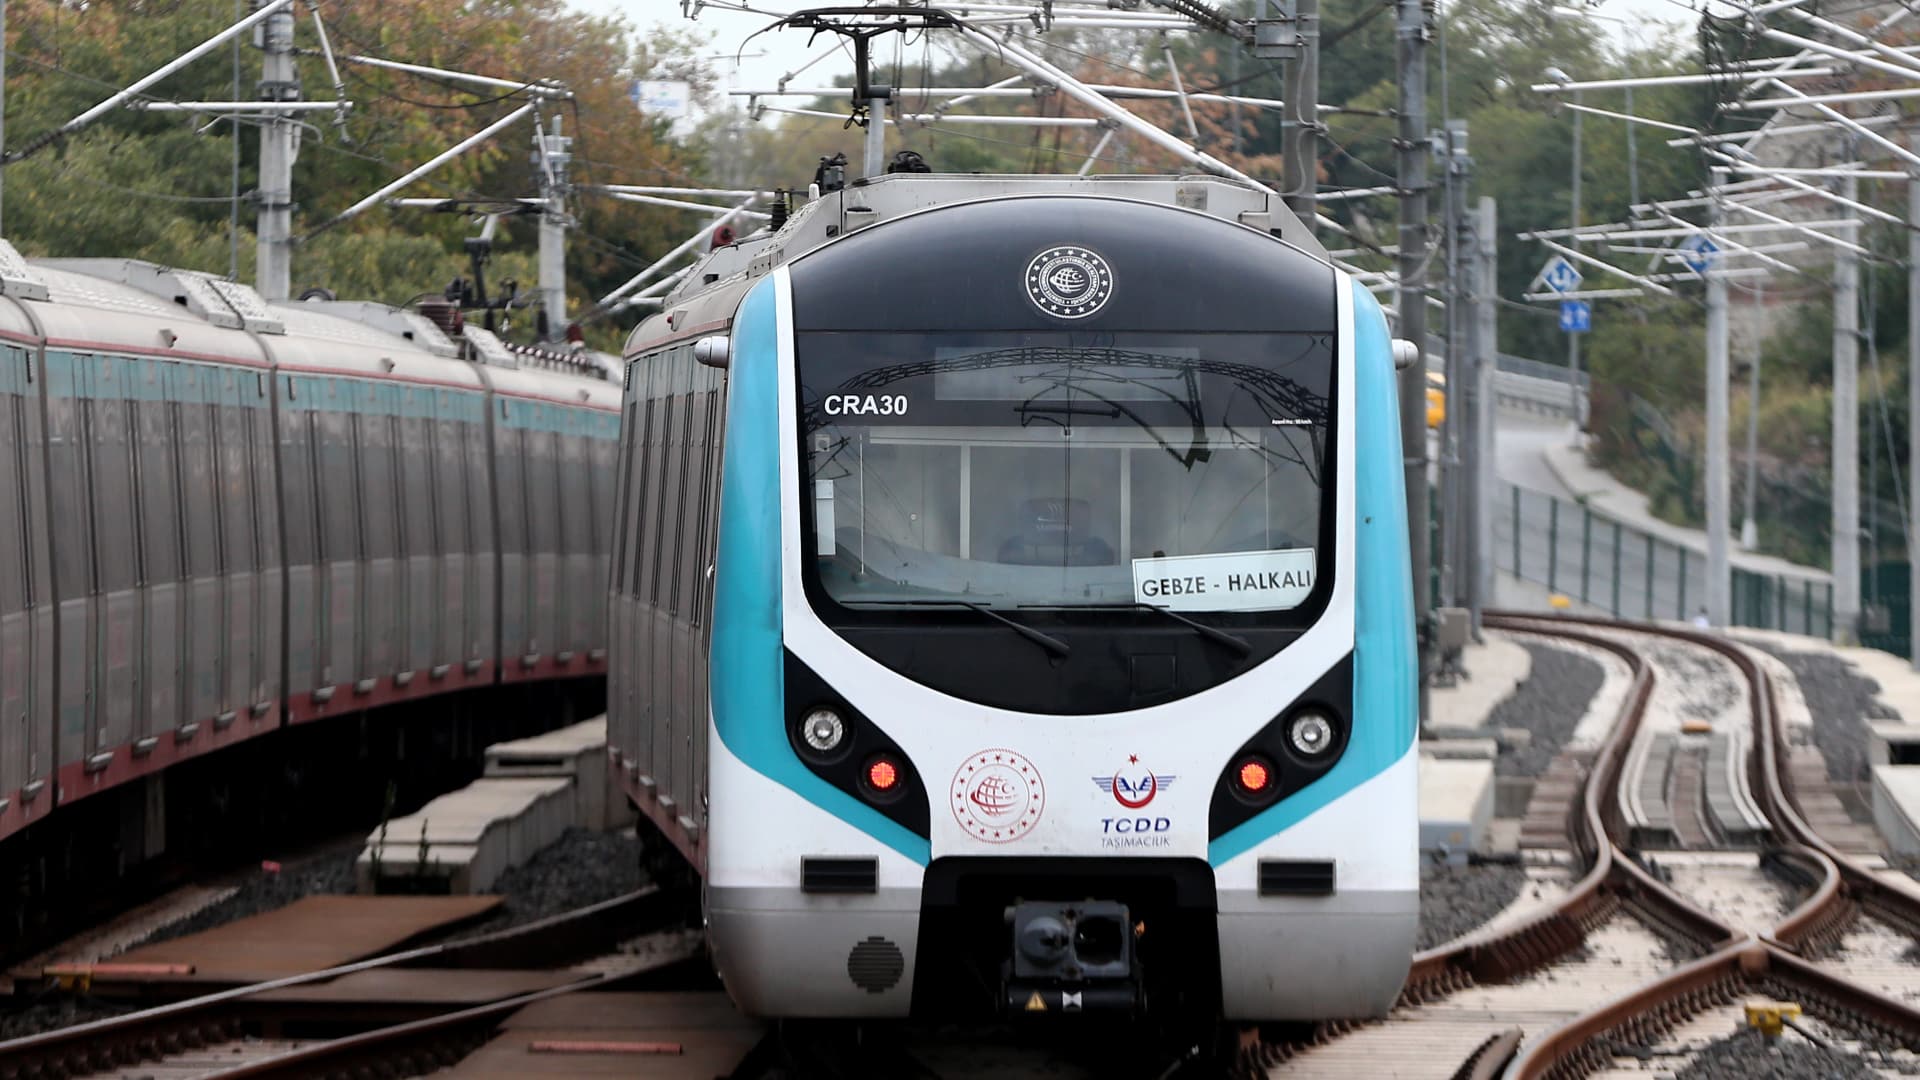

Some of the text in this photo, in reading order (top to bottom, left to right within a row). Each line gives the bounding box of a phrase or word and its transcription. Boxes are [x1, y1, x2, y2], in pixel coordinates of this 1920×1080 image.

[824, 394, 908, 415] CRA30
[1142, 576, 1206, 597] GEBZE
[1228, 570, 1312, 591] HALKALI
[1101, 817, 1171, 834] TCDD
